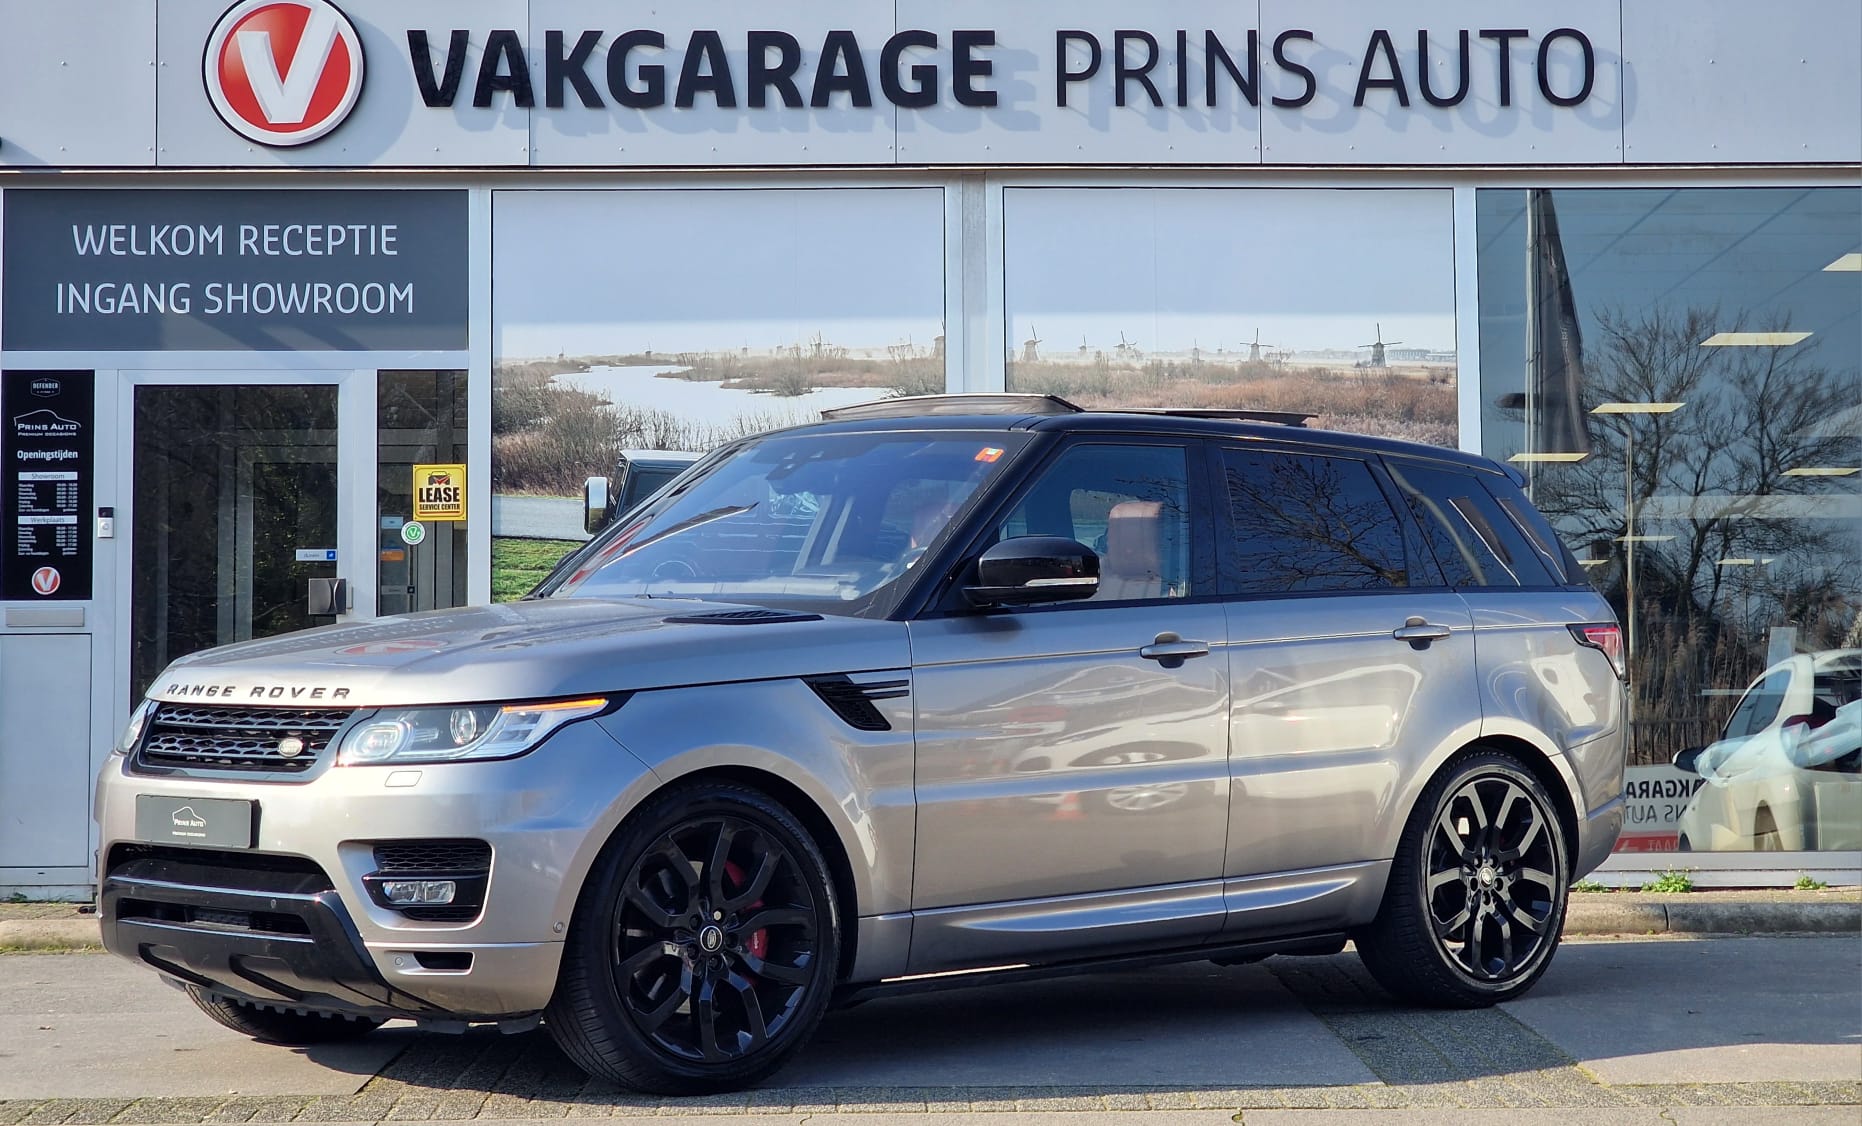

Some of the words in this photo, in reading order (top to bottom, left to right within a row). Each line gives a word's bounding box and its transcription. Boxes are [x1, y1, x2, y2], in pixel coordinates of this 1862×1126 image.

[407, 29, 998, 109] VAKGARAGE
[1056, 29, 1317, 108] PRINS
[1353, 27, 1595, 108] AUTO
[72, 224, 224, 256] WELKOM
[240, 224, 398, 256] RECEPTIE
[56, 283, 191, 314] INGANG
[204, 283, 414, 314] SHOWROOM
[17, 423, 48, 431] PRINS
[50, 423, 77, 431] AUTO
[17, 450, 78, 461] Openingstijden
[419, 487, 460, 503] LEASE
[166, 684, 236, 697] RANGE
[249, 686, 350, 700] ROVER
